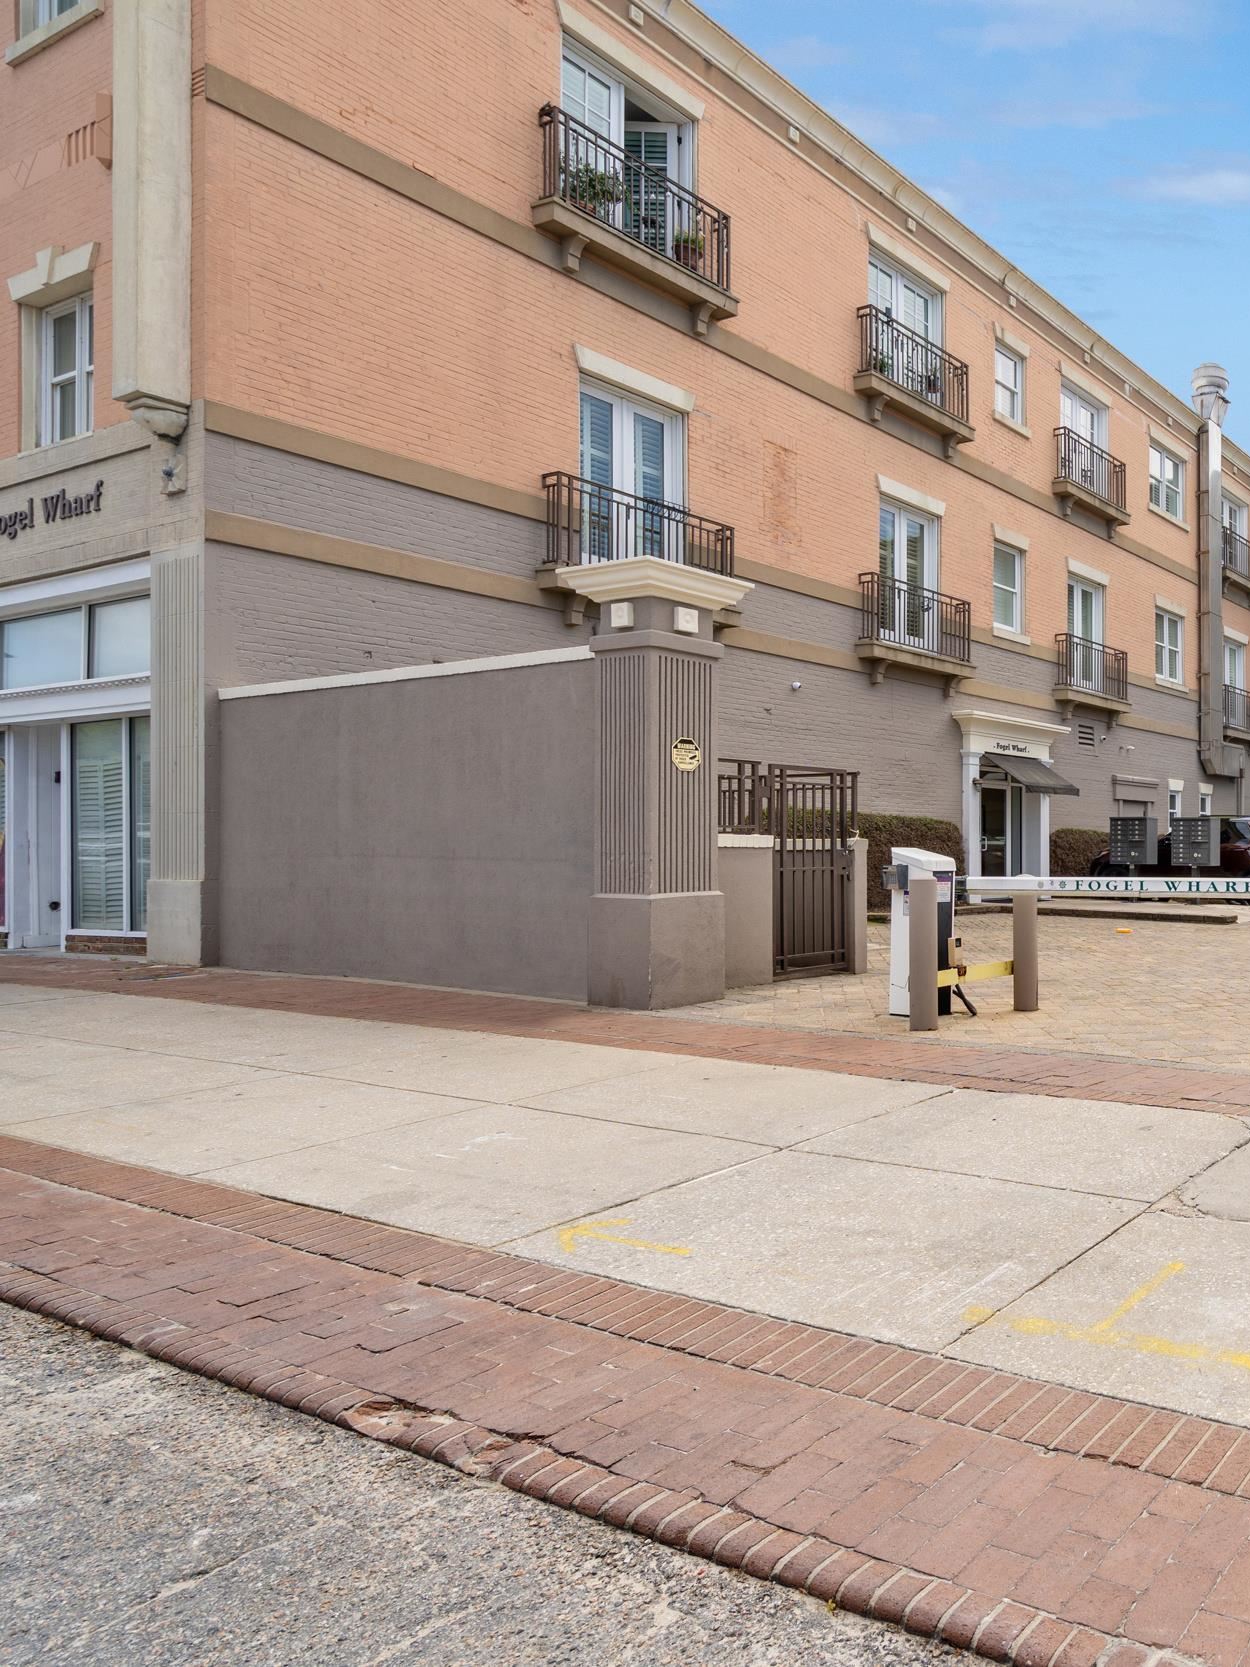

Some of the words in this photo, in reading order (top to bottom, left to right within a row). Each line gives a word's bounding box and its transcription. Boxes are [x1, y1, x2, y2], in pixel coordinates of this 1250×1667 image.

[41, 480, 104, 524] Wharf
[996, 742, 1010, 751] Fogel
[1011, 744, 1028, 753] Wharf
[1074, 879, 1149, 892] FOGEL
